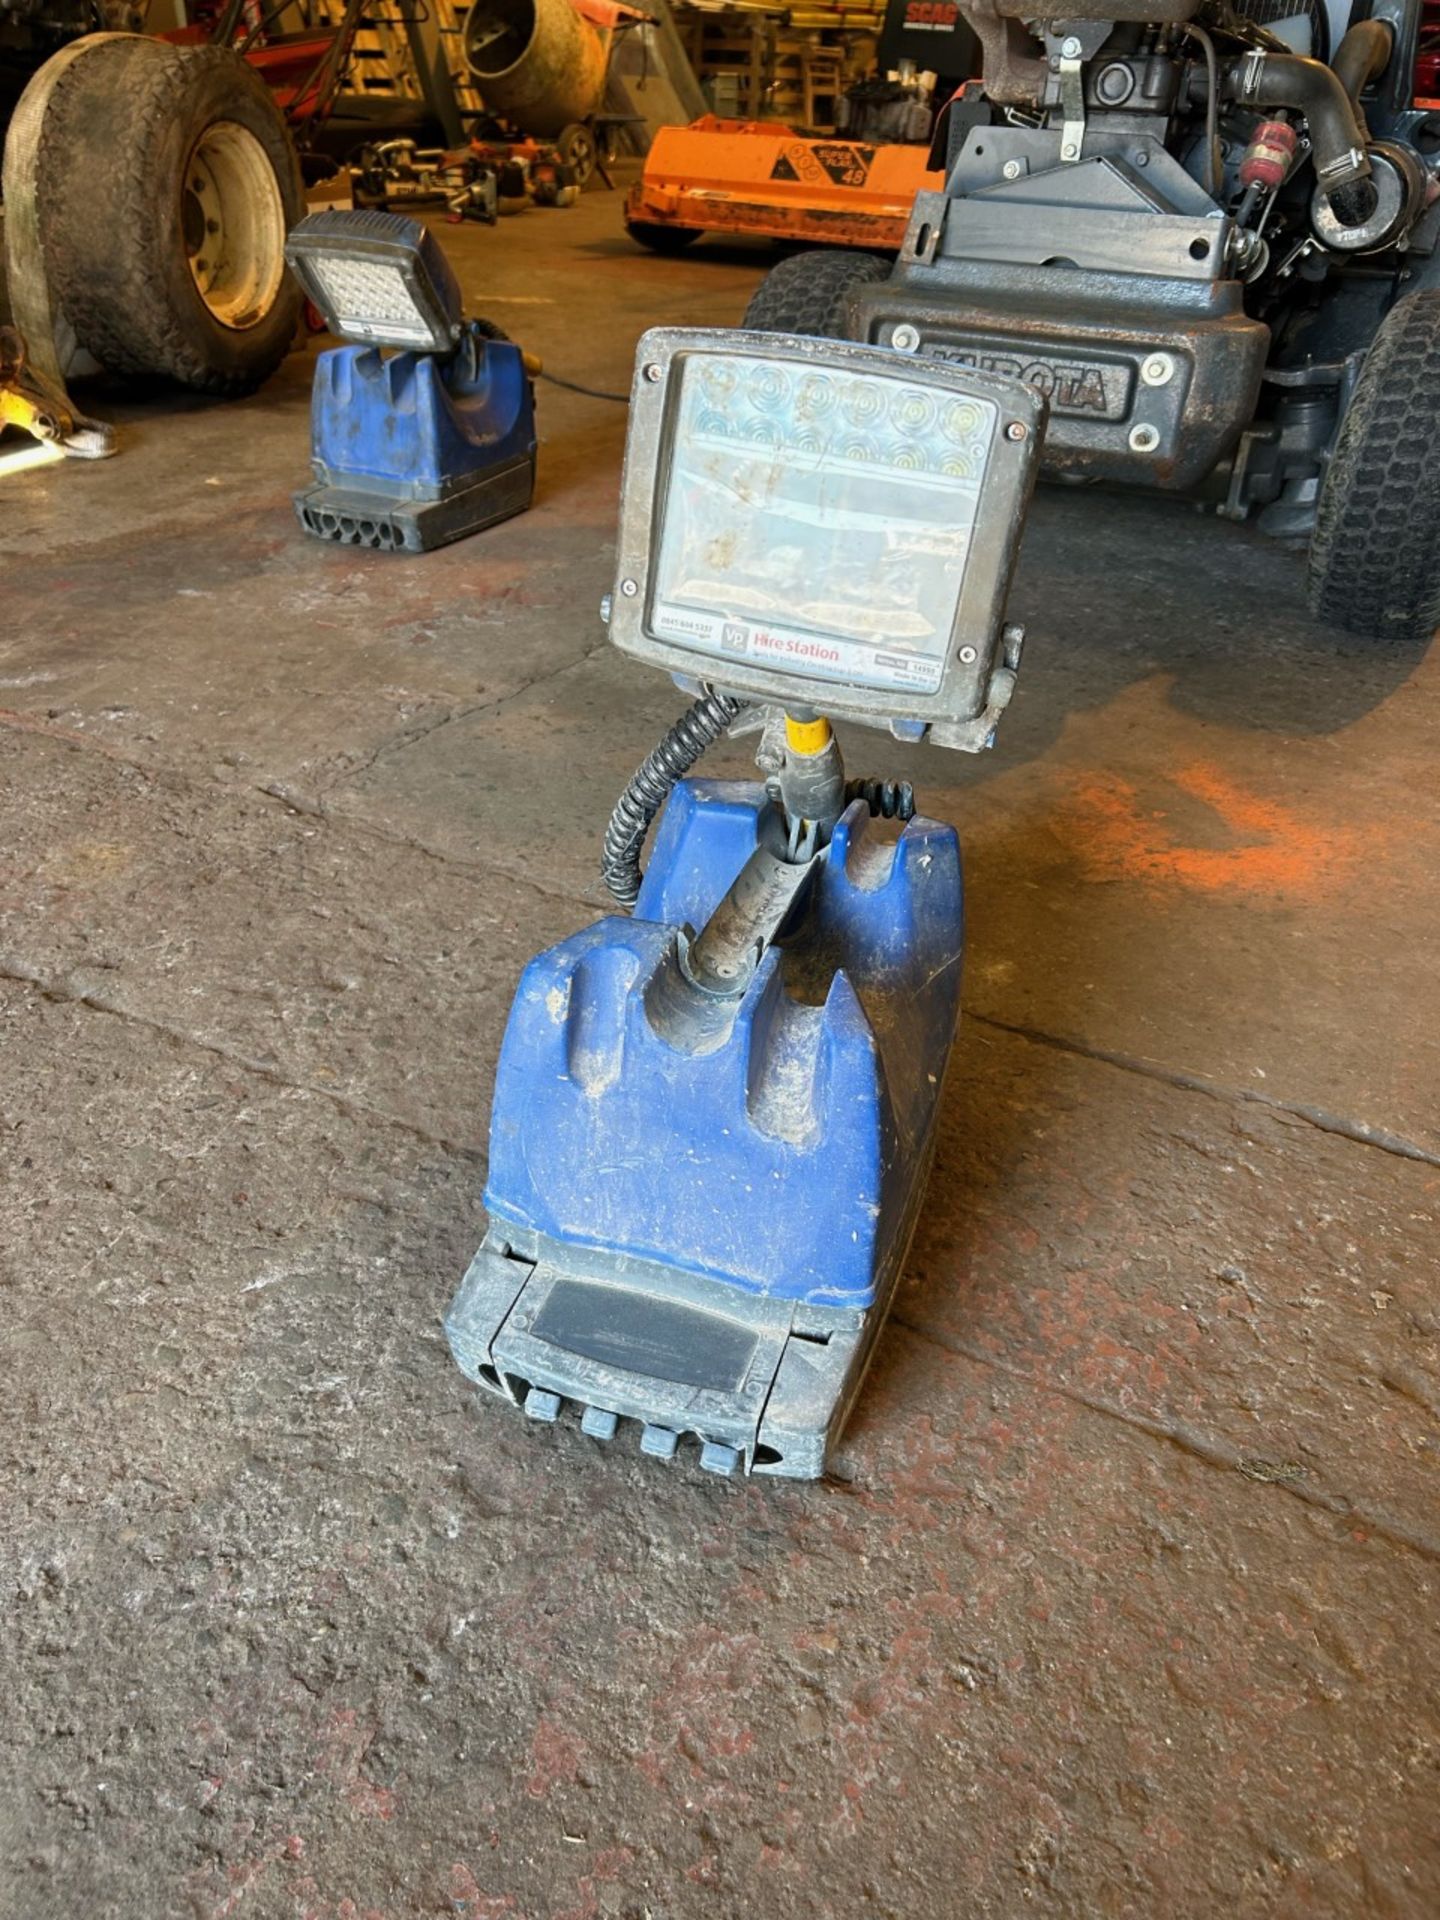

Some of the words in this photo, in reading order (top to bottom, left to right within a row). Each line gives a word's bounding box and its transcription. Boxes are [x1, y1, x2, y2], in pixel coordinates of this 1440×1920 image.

[904, 2, 958, 24] SCAG
[841, 168, 865, 184] 48
[933, 349, 1107, 412] OTA
[725, 627, 744, 645] Vp
[754, 632, 785, 650] Hire
[785, 640, 840, 661] Station
